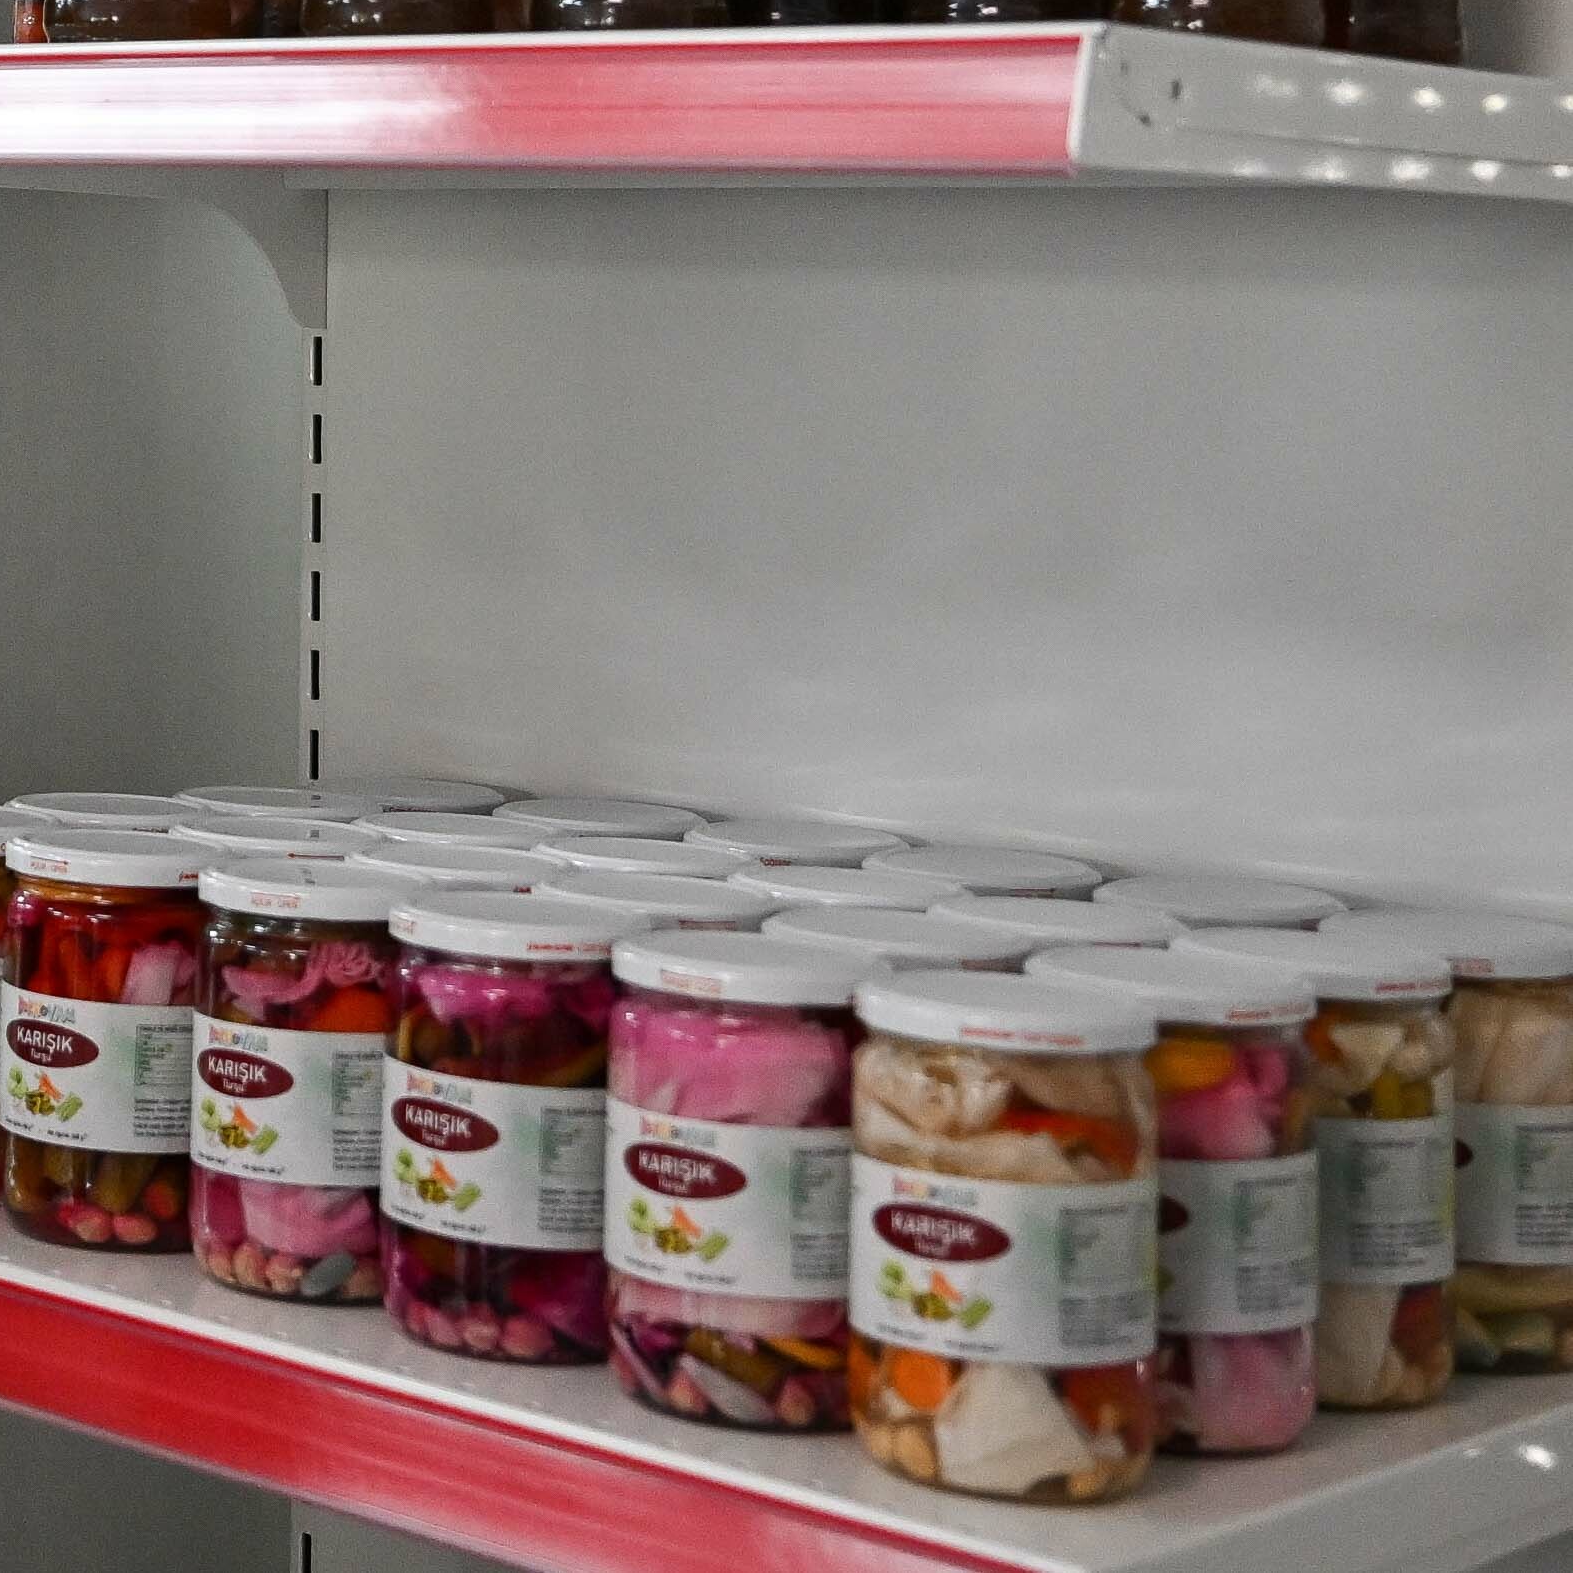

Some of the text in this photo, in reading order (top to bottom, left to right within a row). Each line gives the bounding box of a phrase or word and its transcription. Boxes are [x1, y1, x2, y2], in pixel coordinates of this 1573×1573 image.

[17, 1026, 73, 1055] KARIŞIK
[207, 1054, 266, 1084] KARIŞIK
[404, 1103, 472, 1138] KARIŞIK
[638, 1149, 717, 1184] KARIŞIK
